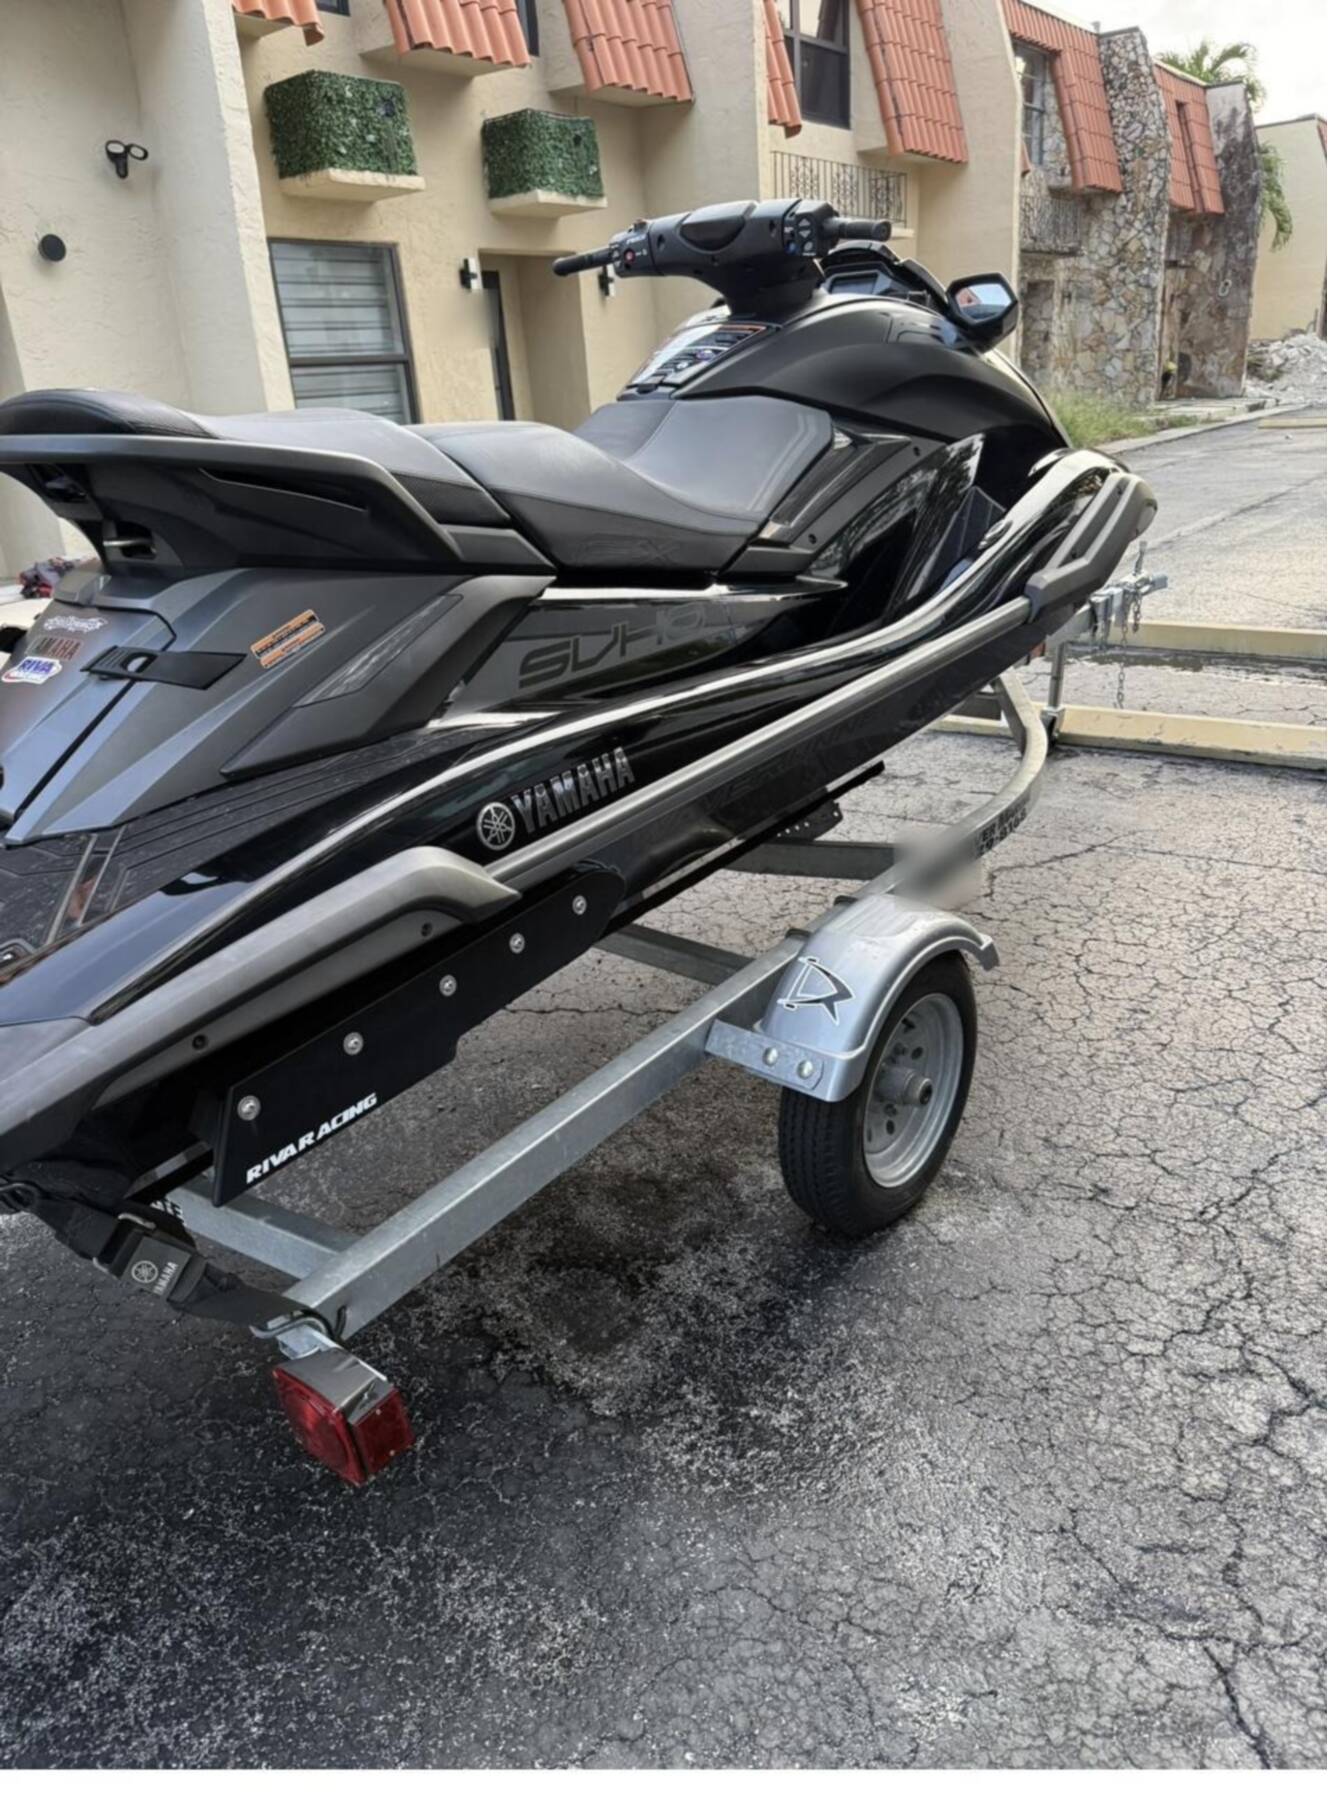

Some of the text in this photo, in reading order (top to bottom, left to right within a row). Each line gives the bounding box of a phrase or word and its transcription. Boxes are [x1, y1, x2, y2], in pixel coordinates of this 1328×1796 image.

[510, 746, 635, 834] YAMAHA
[246, 1092, 378, 1184] RIVA RACING
